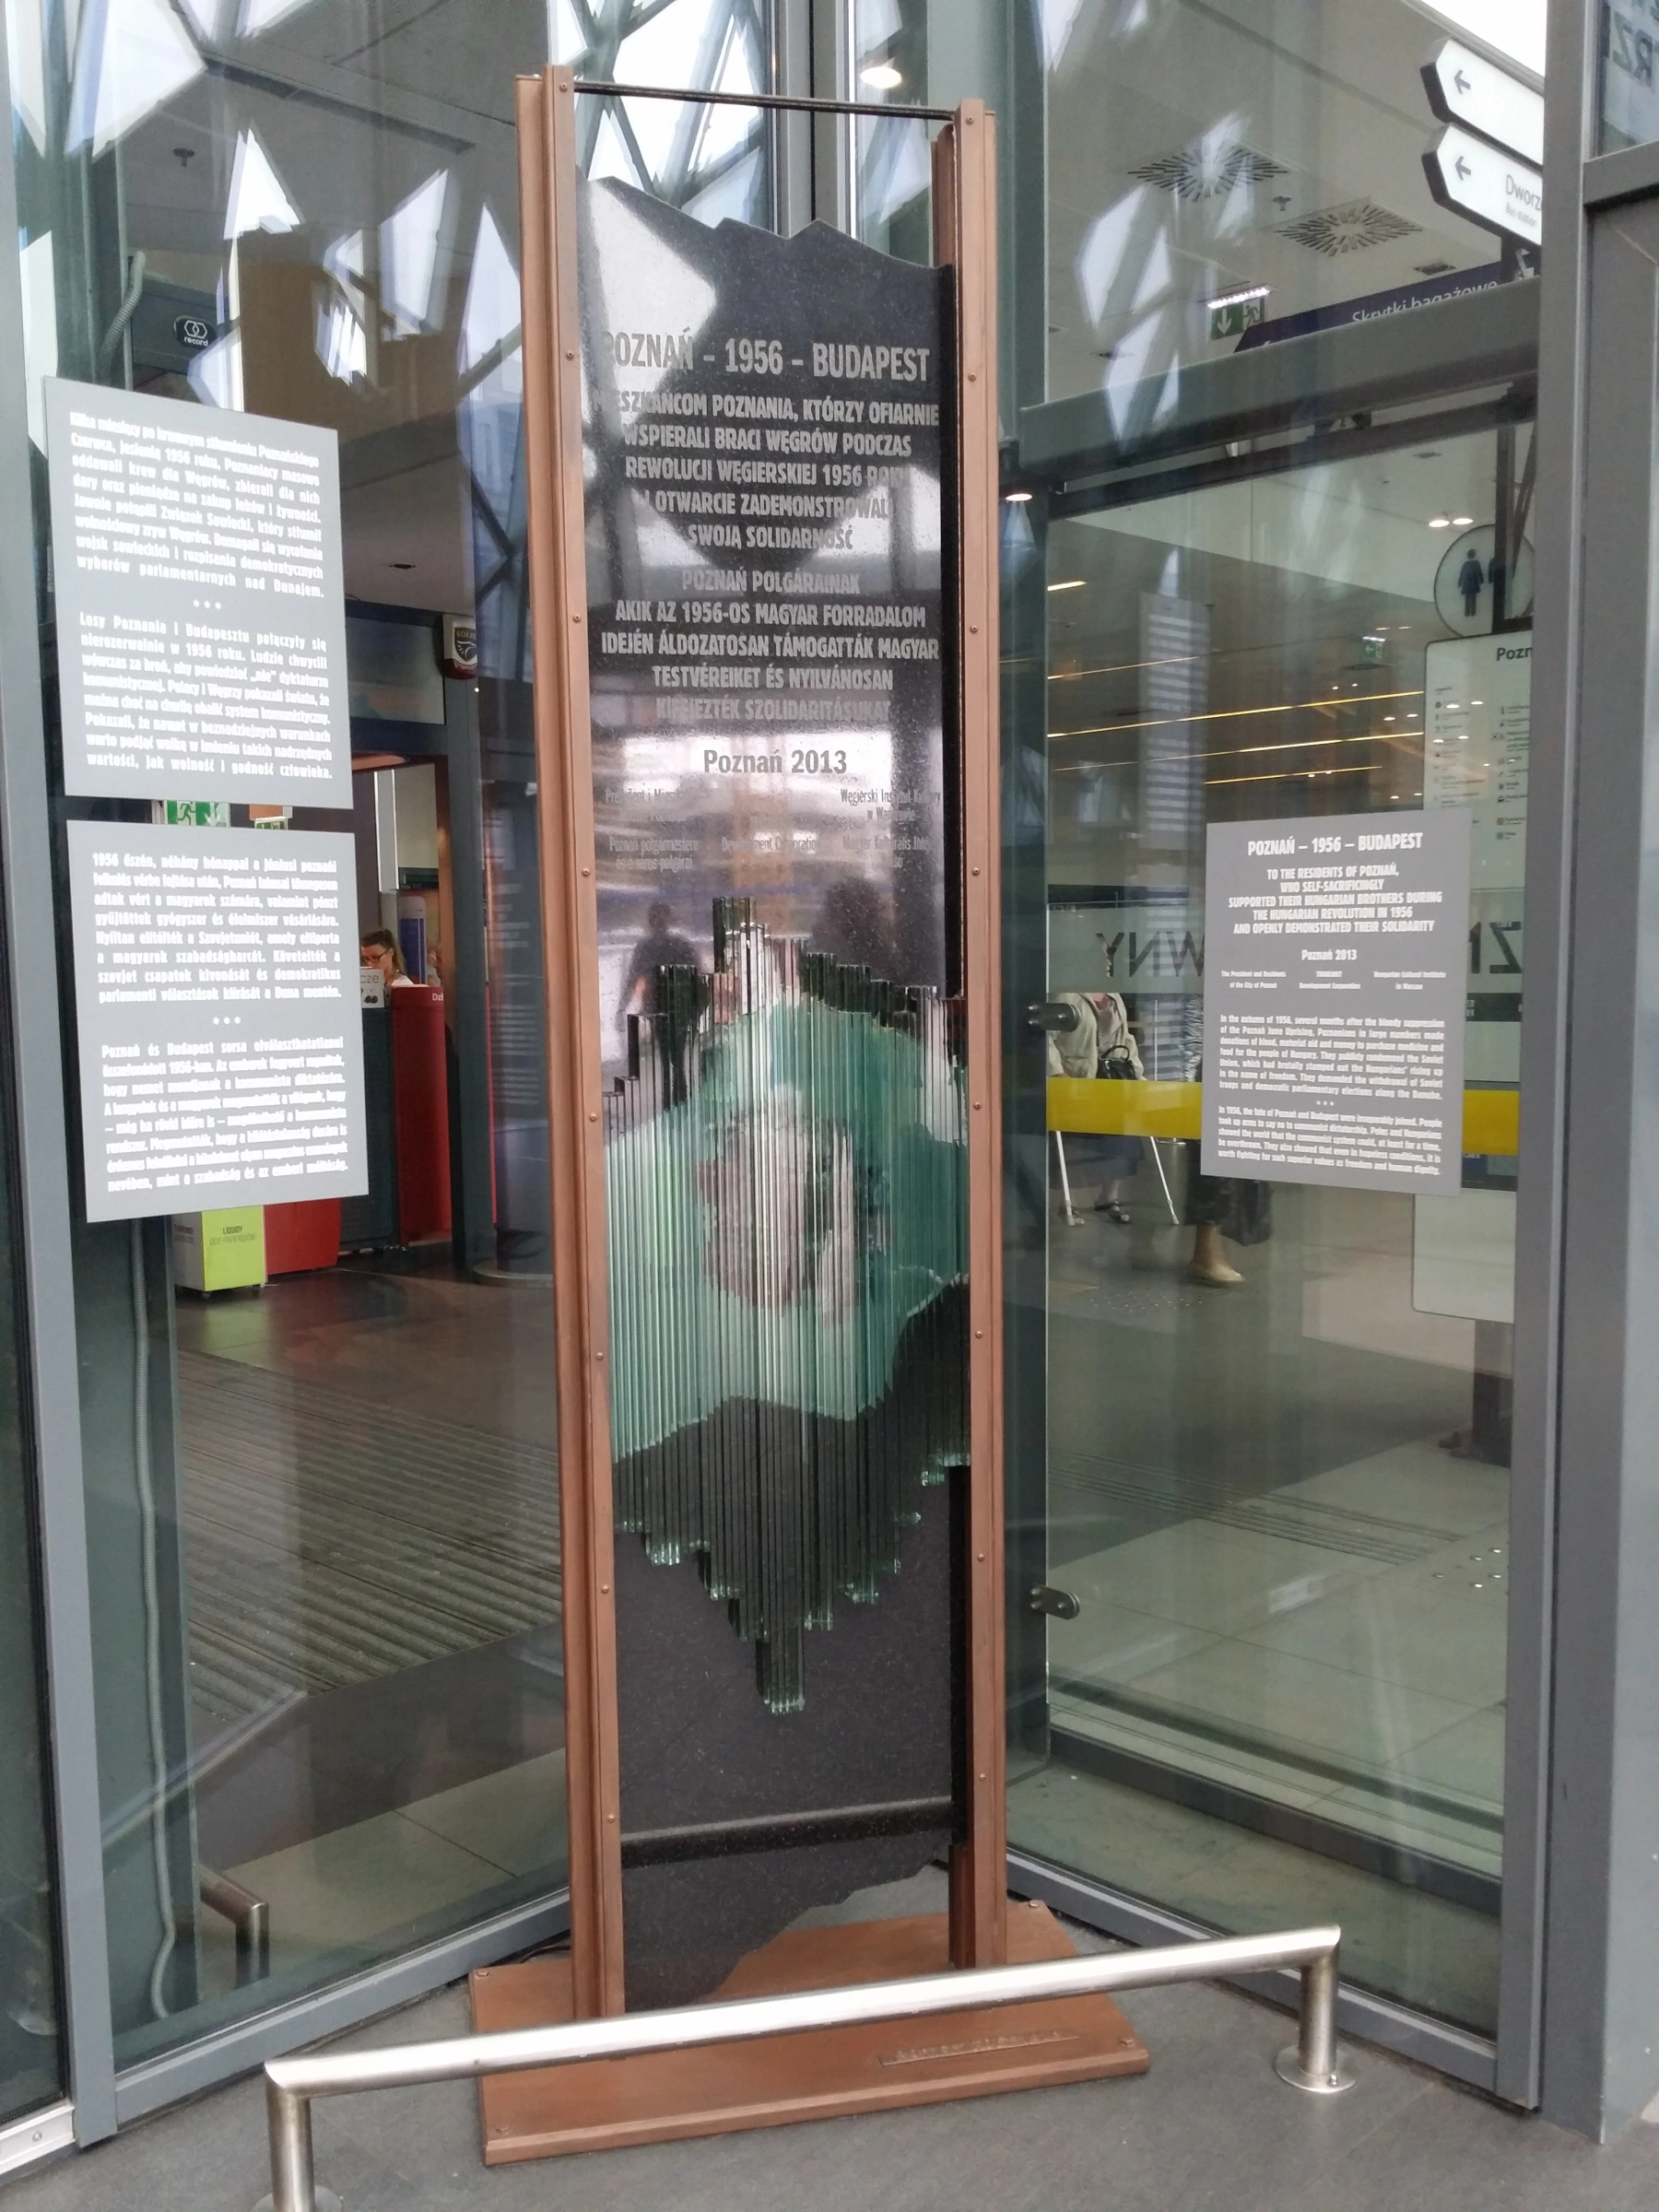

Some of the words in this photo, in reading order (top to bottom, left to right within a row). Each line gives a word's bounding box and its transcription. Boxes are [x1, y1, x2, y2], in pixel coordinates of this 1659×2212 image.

[1506, 174, 1541, 211] Dworz
[184, 336, 208, 347] record
[601, 327, 693, 370] POZNAŃ
[725, 338, 782, 374] 1956
[814, 342, 930, 382] BUDAPEST
[594, 388, 707, 416] SZKAŃCOM
[712, 394, 798, 422] POZNANIA,
[804, 395, 864, 422] KTÓRZY
[869, 402, 939, 426] OFIARNIE
[625, 424, 710, 448] WSPIERALI
[715, 427, 760, 451] BRACI
[766, 428, 837, 454] WĘGRÓW
[843, 433, 912, 456] PODCZAS
[626, 456, 712, 481] REWOLUCJI
[718, 459, 817, 485] WĘGIERSKIEJ
[822, 465, 862, 487] 1956
[656, 491, 735, 514] OTWARCIE
[688, 524, 742, 550] SWOJĄ
[747, 524, 853, 549] SOLIDARNOŚĆ
[683, 566, 747, 592] POZNAŃ
[753, 568, 860, 594] POLGÁRAINAK
[616, 600, 651, 622] AKIK
[656, 602, 677, 623] AZ
[683, 603, 750, 625] 1956-OS
[757, 605, 818, 626] MAGYAR
[823, 606, 925, 628] FORRADALOM
[602, 629, 653, 654] IDEJÉN
[659, 629, 769, 657] ÁLDOZATOSAN
[774, 632, 873, 659] TÁMOGATTÁK
[878, 637, 938, 660] MAGYAR
[653, 663, 760, 688] TESTVÉREIKET
[766, 664, 783, 688] ÉS
[790, 664, 892, 690] NYILVÁNOSAN
[704, 748, 782, 773] Poznań
[792, 750, 847, 773] 2013
[1248, 836, 1295, 855] POZNAŃ
[1312, 837, 1341, 853] 1956
[1359, 832, 1423, 851] BUDAPEST
[1267, 869, 1278, 879] TO
[1280, 868, 1296, 879] THE
[1298, 866, 1343, 878] RESIDENTS
[1346, 865, 1358, 877] OF
[1359, 862, 1399, 877] POZNAŃ,
[1229, 896, 1276, 908] SUPPORTED
[1278, 895, 1302, 906] THEIR
[1304, 894, 1355, 906] HUNGARIAN
[1358, 892, 1404, 905] BROTHERS
[1406, 891, 1442, 903] DURING
[1253, 910, 1268, 921] THE
[1270, 909, 1319, 920] HUNGARIAN
[1377, 907, 1387, 918] IN
[1390, 906, 1413, 918] 1956
[1233, 924, 1251, 934] AND
[1253, 923, 1283, 934] OPENLY
[1354, 921, 1379, 932] THEIR
[1301, 949, 1333, 960] Poznań
[1335, 949, 1357, 960] 2013
